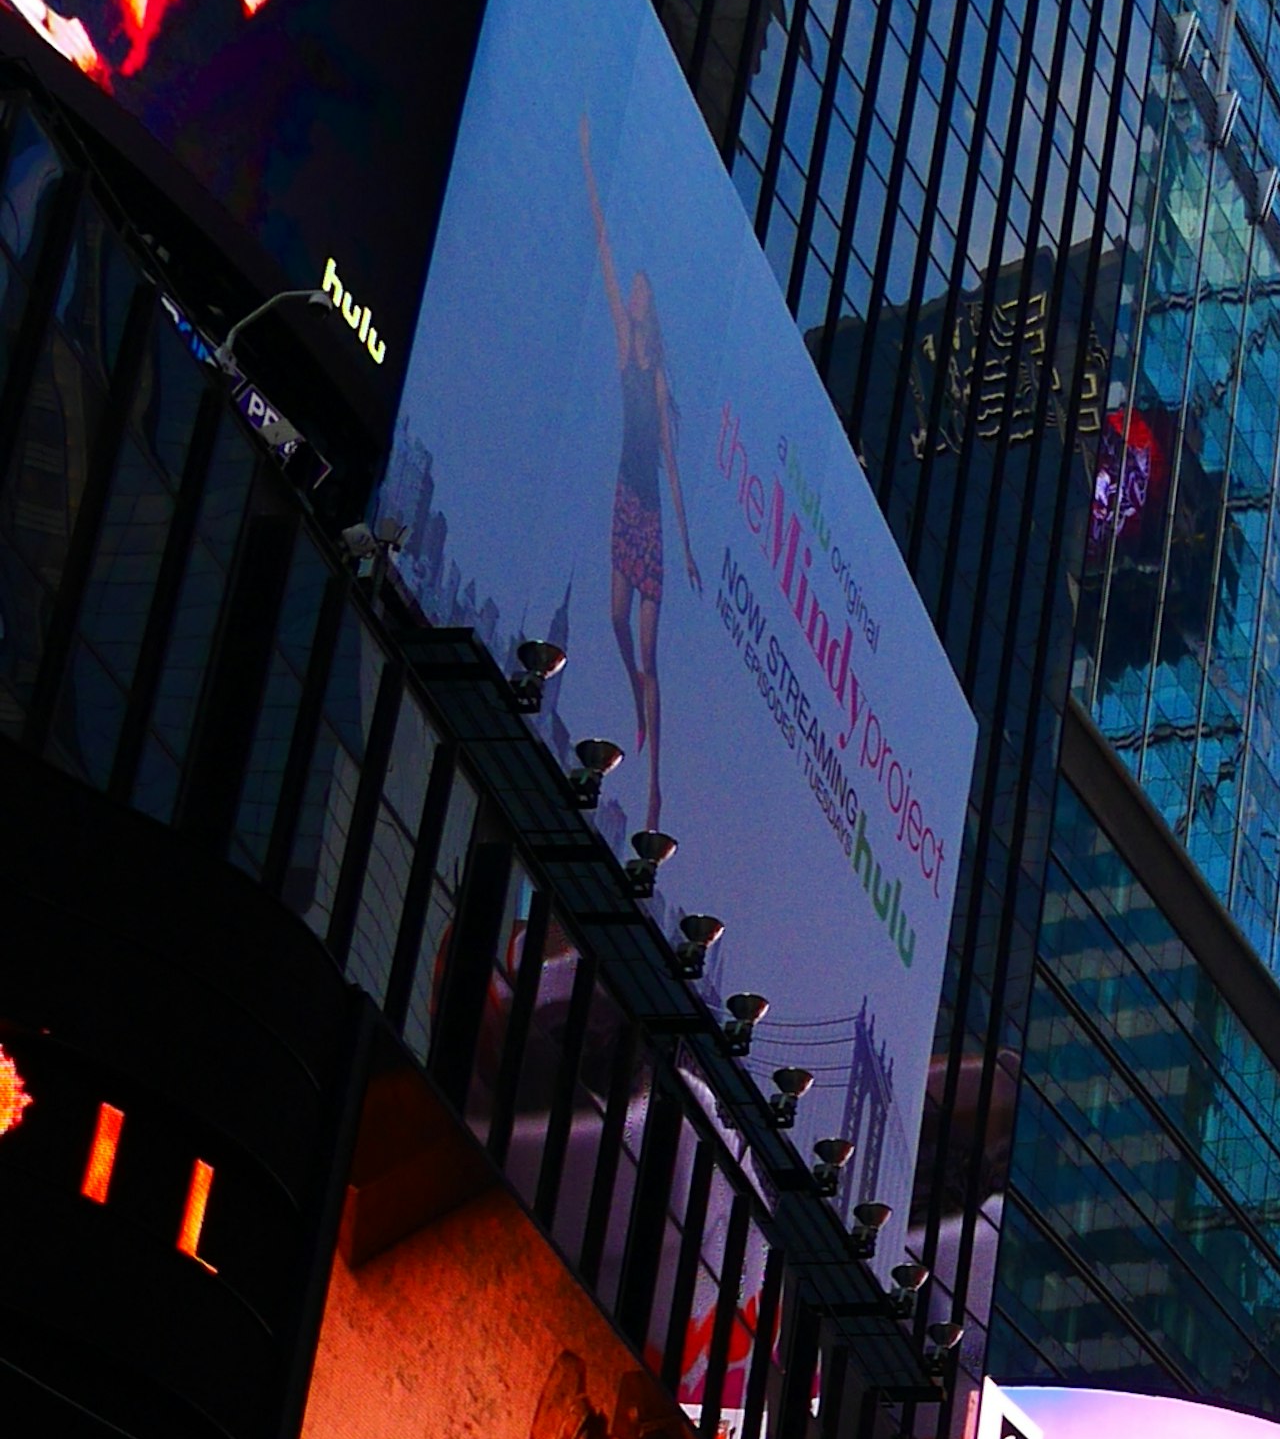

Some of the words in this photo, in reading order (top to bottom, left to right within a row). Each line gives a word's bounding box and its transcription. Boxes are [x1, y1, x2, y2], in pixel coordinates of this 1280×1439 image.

[322, 258, 386, 364] hulu
[721, 546, 768, 646] NOW
[766, 638, 860, 829] STREAMING
[830, 544, 882, 654] original
[715, 587, 744, 648] NEW
[743, 645, 796, 751] EPISODES
[802, 751, 853, 859] TUESDAYS
[860, 701, 946, 899] project
[853, 810, 917, 969] hulu
